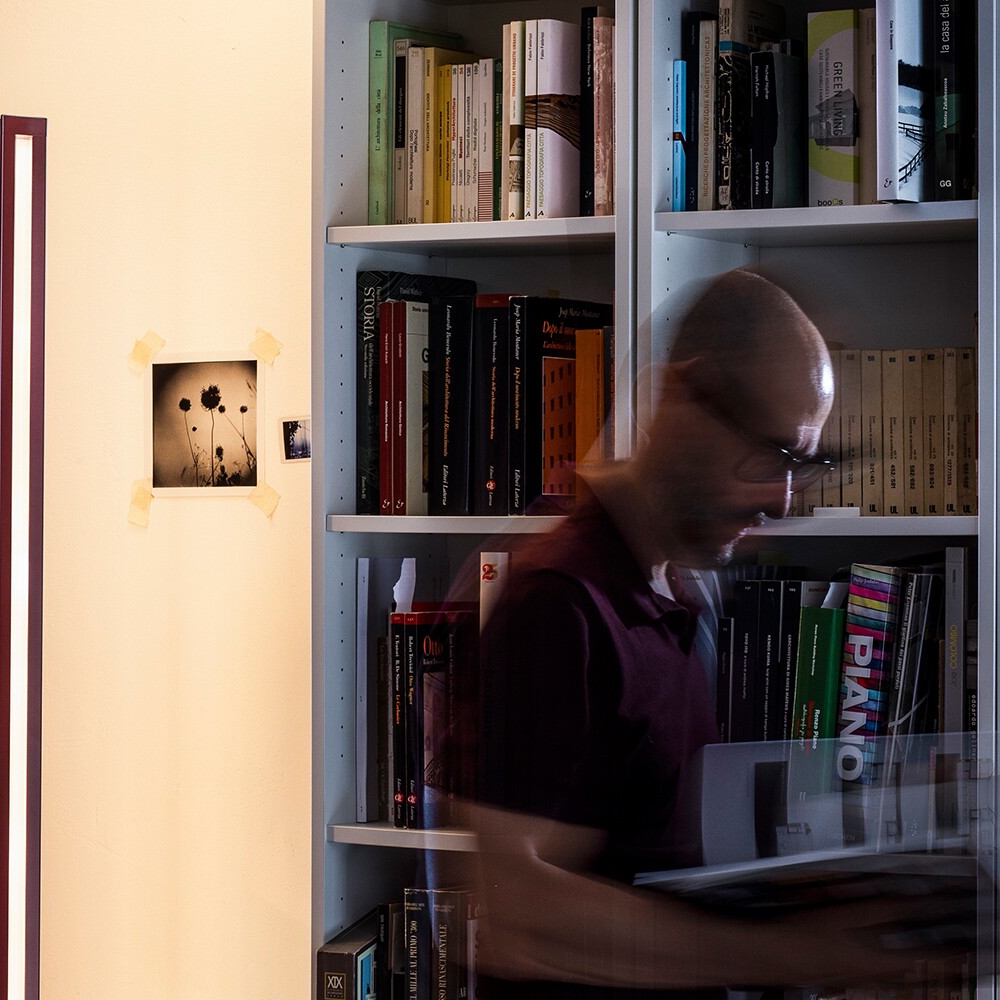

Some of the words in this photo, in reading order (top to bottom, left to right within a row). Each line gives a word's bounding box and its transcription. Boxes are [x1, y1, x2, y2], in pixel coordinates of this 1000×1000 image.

[939, 4, 950, 18] del
[939, 20, 950, 42] casa
[939, 42, 950, 53] la
[703, 41, 711, 98] ARCHITETTONICA
[833, 61, 843, 97] GREEN
[833, 101, 843, 136] LIVING
[939, 180, 952, 188] GG
[363, 287, 375, 342] STORIA
[542, 320, 558, 338] Dopo
[869, 504, 877, 513] UL
[890, 505, 898, 514] UL
[910, 506, 918, 515] UL
[929, 505, 937, 514] UL
[946, 503, 955, 512] UL
[963, 505, 971, 514] UL
[949, 623, 958, 668] COLOMBO
[836, 634, 874, 781] PIANO
[813, 709, 821, 730] Renzo
[409, 935, 418, 959] PRIMO
[438, 924, 448, 988] RINASCIMENTALE
[409, 959, 418, 968] AL
[327, 976, 343, 989] XIX
[409, 970, 418, 993] MILLE
